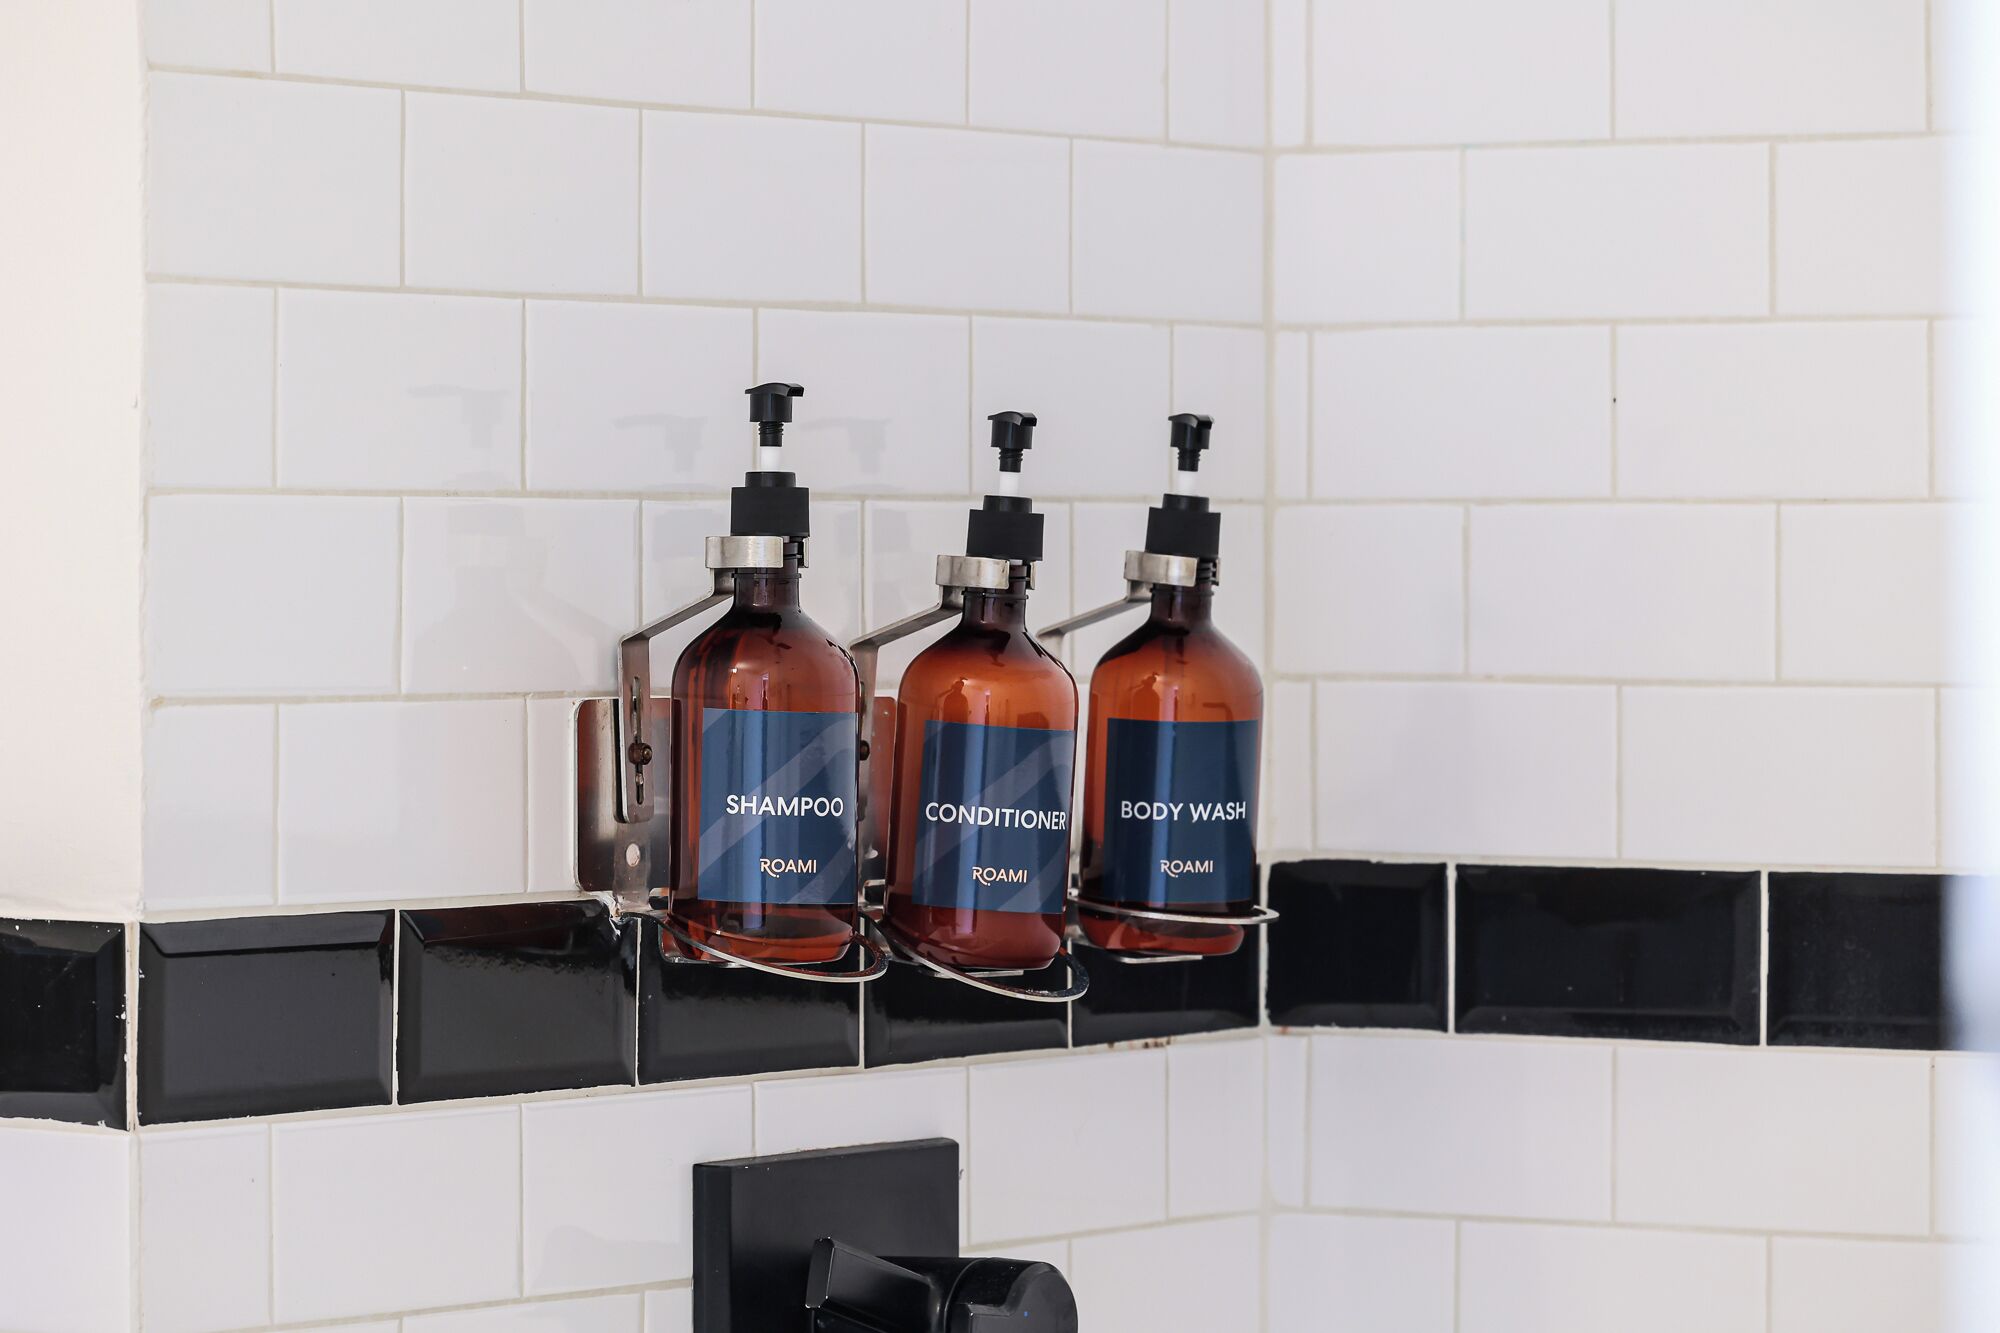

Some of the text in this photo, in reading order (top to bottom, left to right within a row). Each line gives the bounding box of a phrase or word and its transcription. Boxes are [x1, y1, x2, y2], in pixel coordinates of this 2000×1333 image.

[725, 794, 845, 818] SHAMPOO
[925, 801, 1067, 831] CONDITIONER
[1120, 800, 1247, 822] BODY WASH
[759, 858, 817, 878] ROAMI
[971, 866, 1028, 887] ROAMI
[1159, 859, 1214, 878] ROAMI
